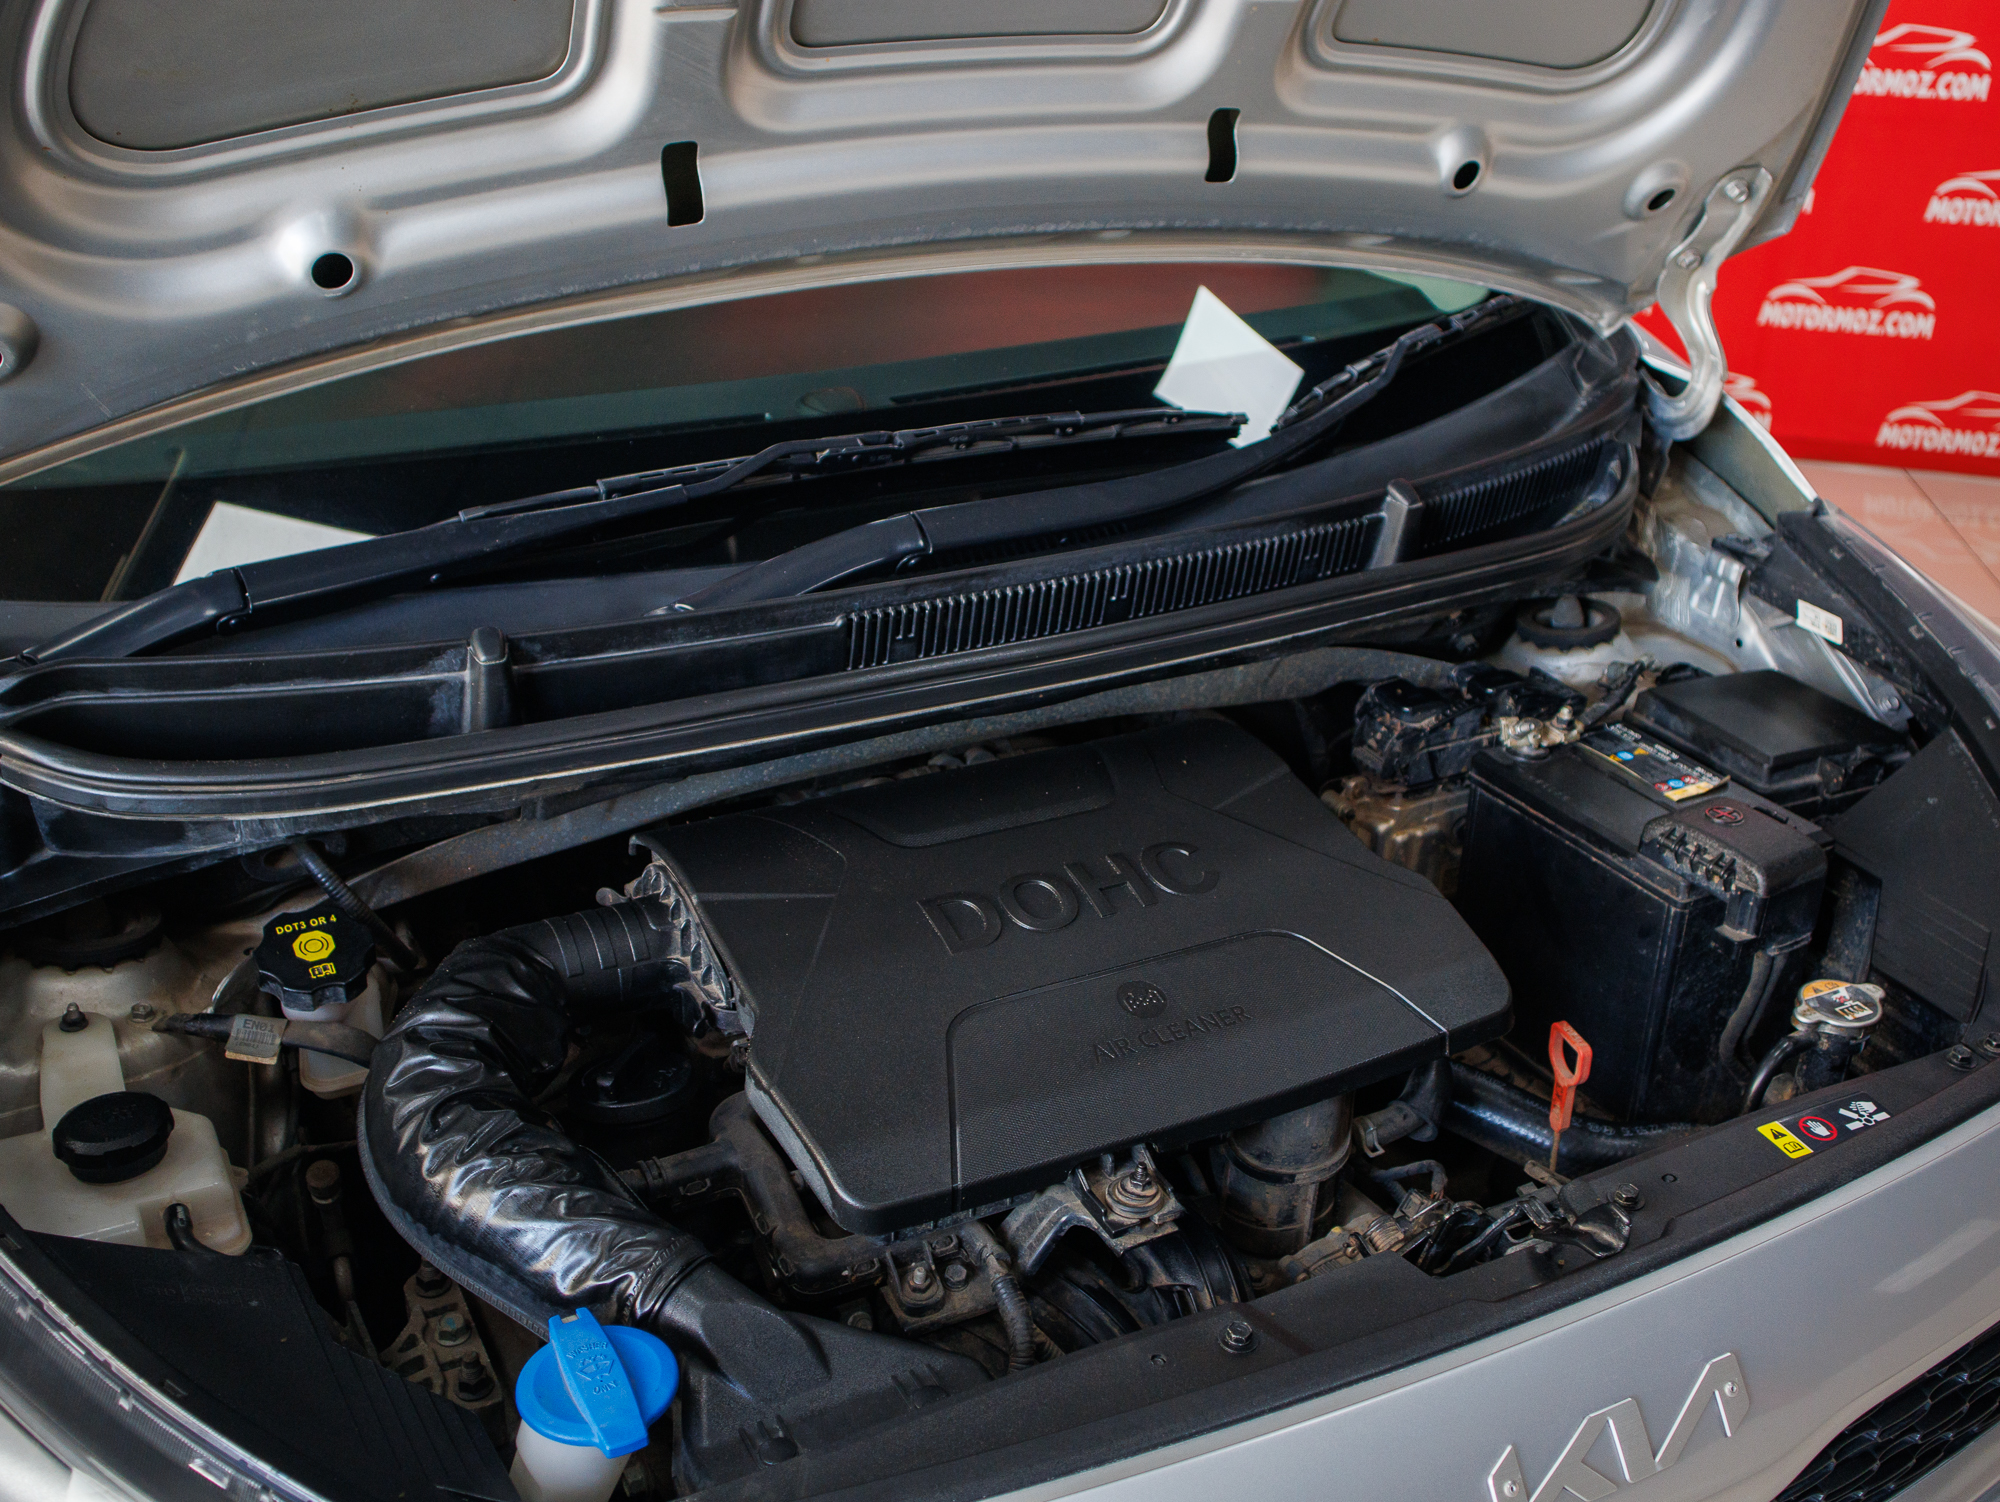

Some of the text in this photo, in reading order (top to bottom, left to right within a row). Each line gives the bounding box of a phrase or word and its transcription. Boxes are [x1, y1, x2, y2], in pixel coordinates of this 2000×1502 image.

[1757, 300, 1936, 340] MOTORMOZ.COM
[917, 841, 1220, 956] DOHC
[275, 914, 338, 935] DOT3 OR 4
[1093, 1005, 1252, 1064] AIR CLEANER
[566, 1341, 608, 1359] WASHER
[1487, 1352, 1747, 1502] KIA
